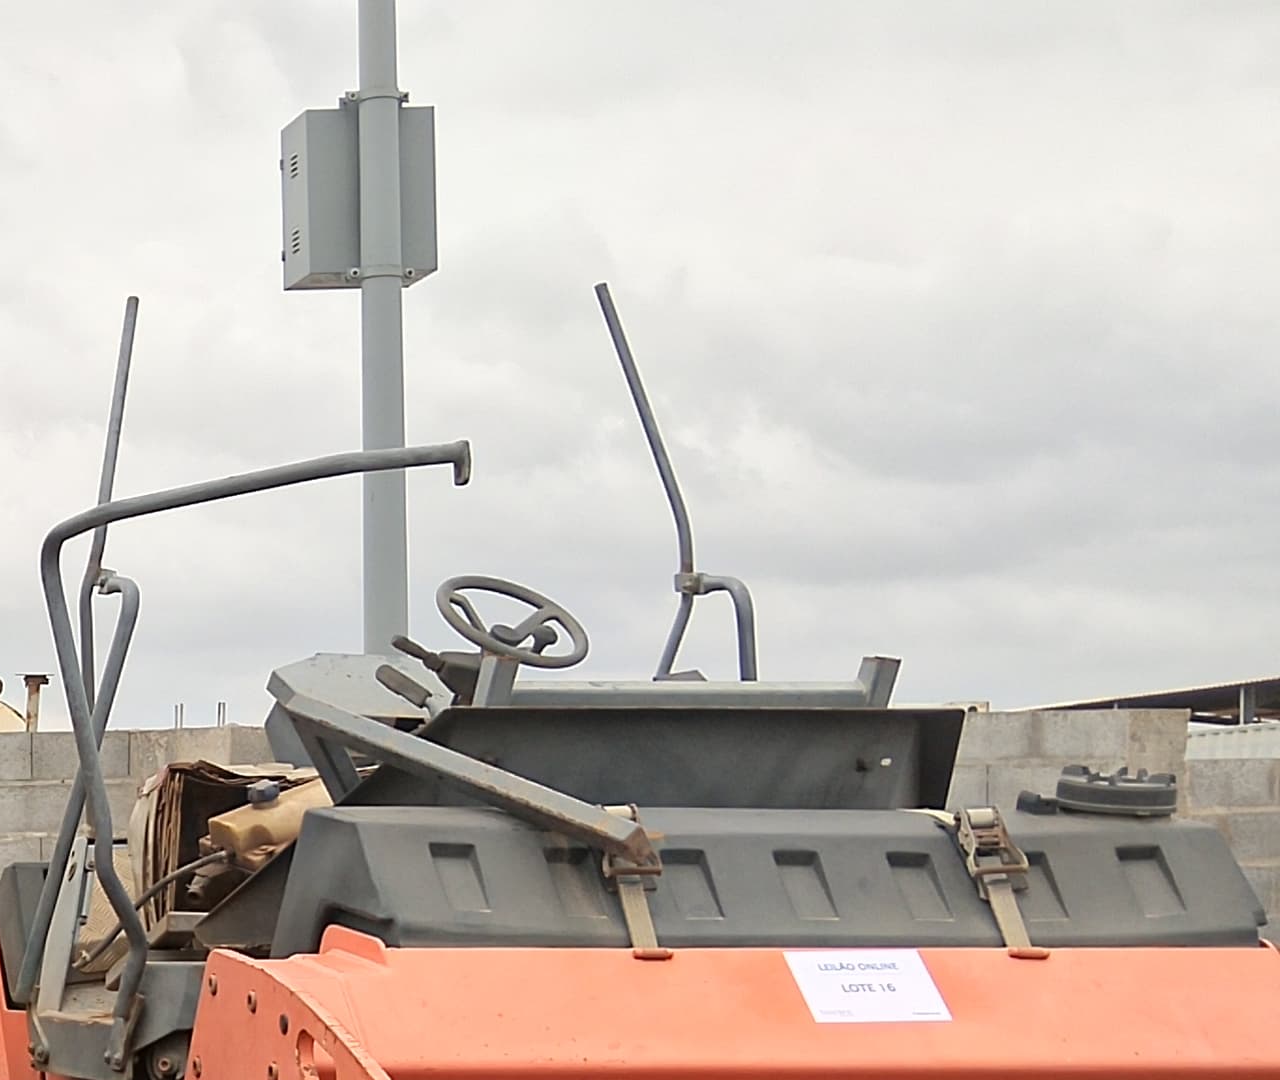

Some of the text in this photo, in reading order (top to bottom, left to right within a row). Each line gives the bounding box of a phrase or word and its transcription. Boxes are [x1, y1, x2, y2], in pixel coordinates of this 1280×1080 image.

[816, 961, 900, 972] LEILÃO ONLINE
[840, 983, 897, 993] LOTE 16
